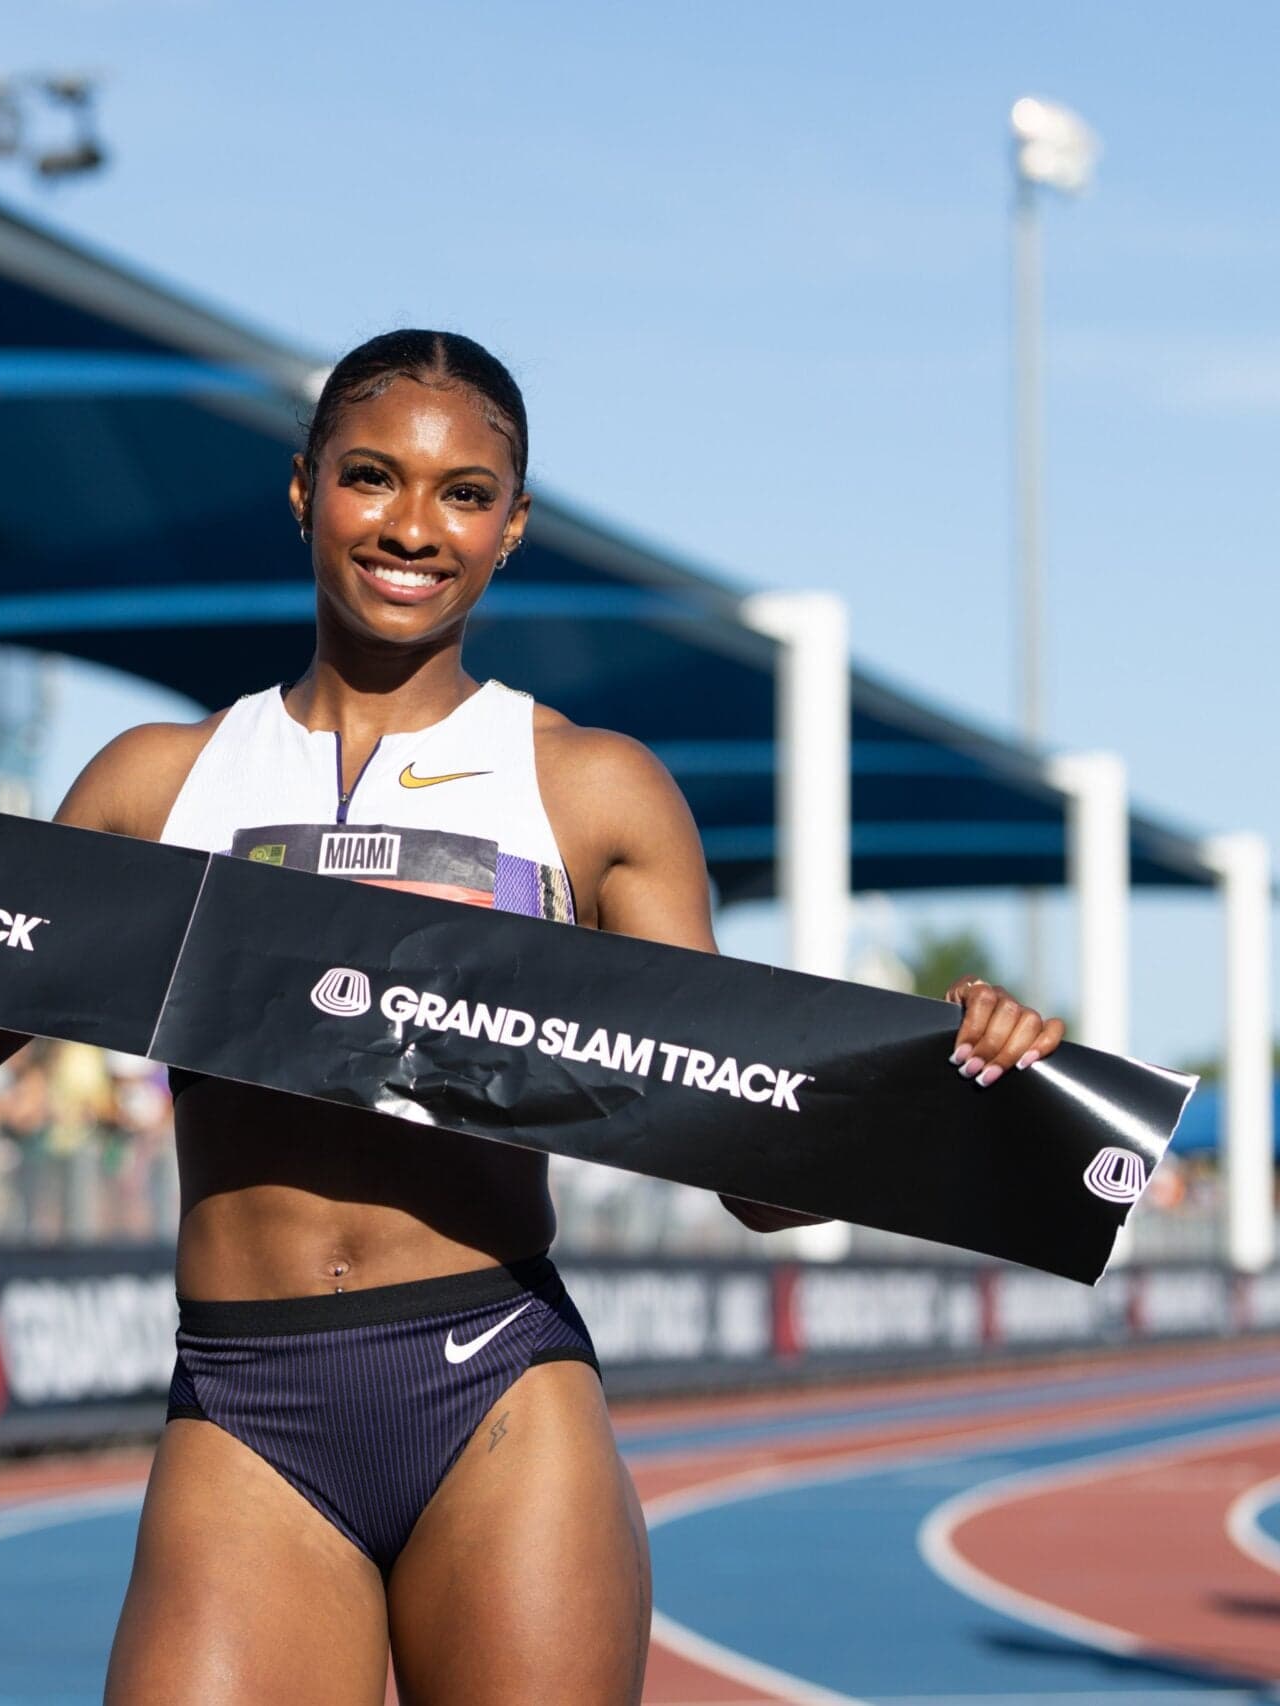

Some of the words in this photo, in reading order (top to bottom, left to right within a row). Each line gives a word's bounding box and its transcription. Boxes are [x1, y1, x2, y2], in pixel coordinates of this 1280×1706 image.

[324, 837, 394, 869] MIAMI
[380, 986, 535, 1048] GRAND
[536, 1017, 657, 1077] SLAM
[657, 1042, 806, 1113] TRACK
